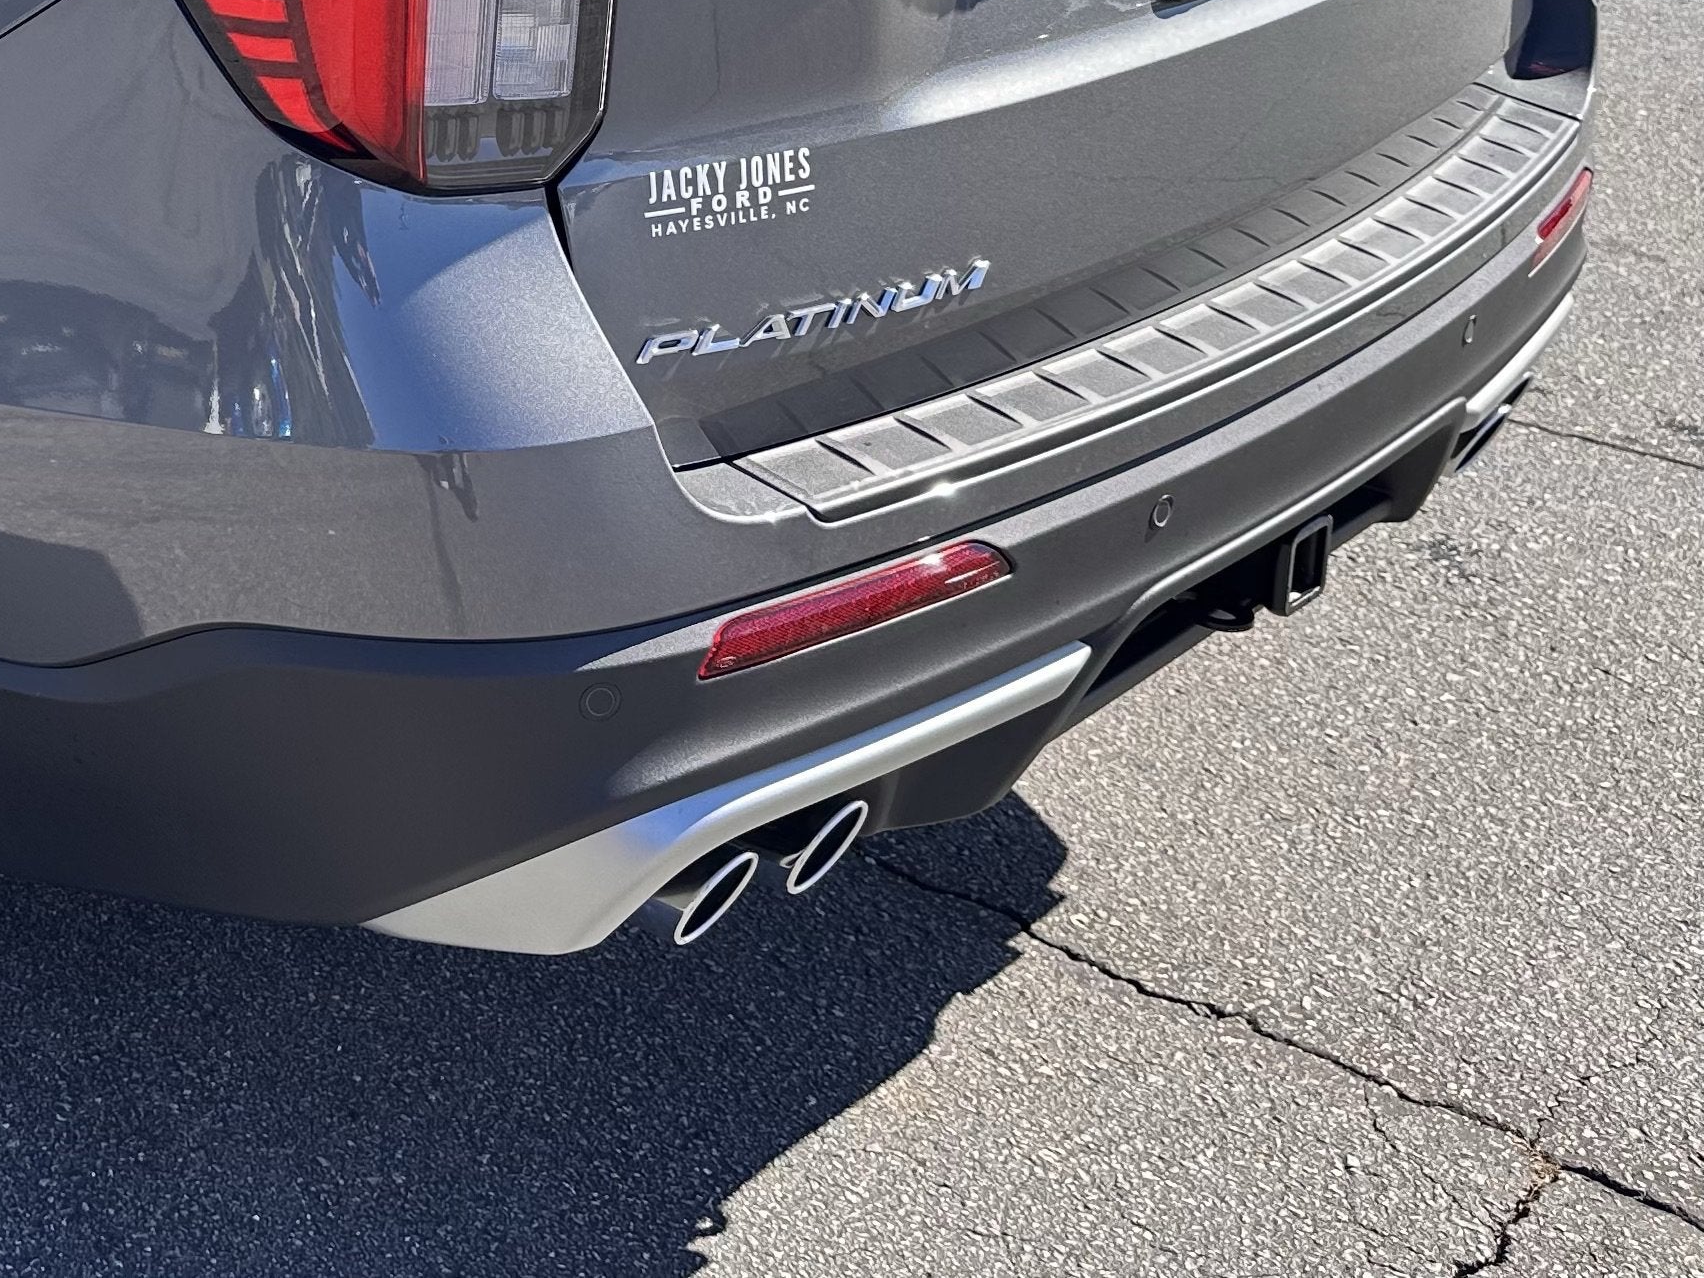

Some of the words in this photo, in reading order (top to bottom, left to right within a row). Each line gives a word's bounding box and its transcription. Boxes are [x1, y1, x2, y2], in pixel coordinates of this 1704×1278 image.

[648, 161, 727, 205] JACKY
[739, 147, 811, 191] JONES
[690, 185, 773, 216] FORD
[651, 206, 776, 238] HAYESVILLE,
[786, 197, 810, 215] NC
[635, 258, 992, 366] PLATINUM
